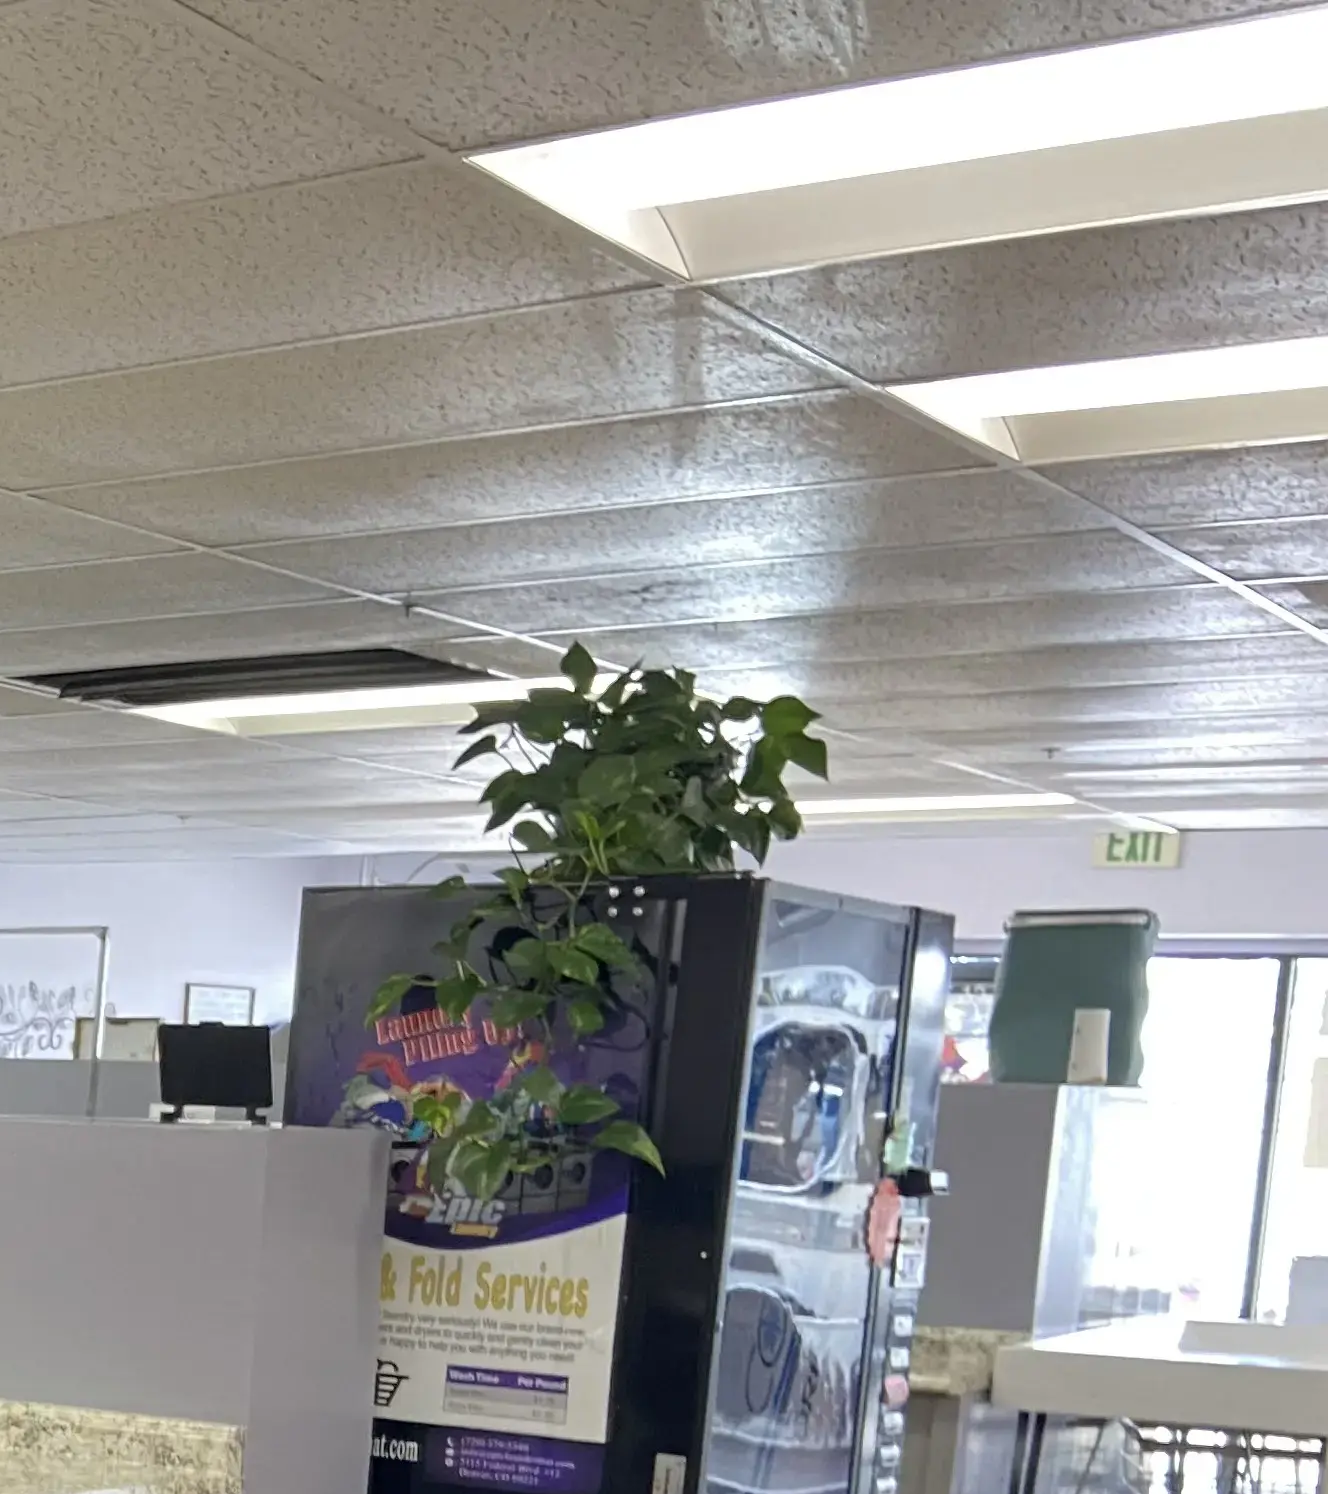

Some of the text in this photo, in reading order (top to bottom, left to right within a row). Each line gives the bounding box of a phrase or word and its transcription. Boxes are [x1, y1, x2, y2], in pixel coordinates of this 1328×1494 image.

[1107, 832, 1162, 862] EXIT
[409, 1256, 462, 1307] Fold
[474, 1262, 590, 1318] Services
[372, 1434, 419, 1462] at.com
